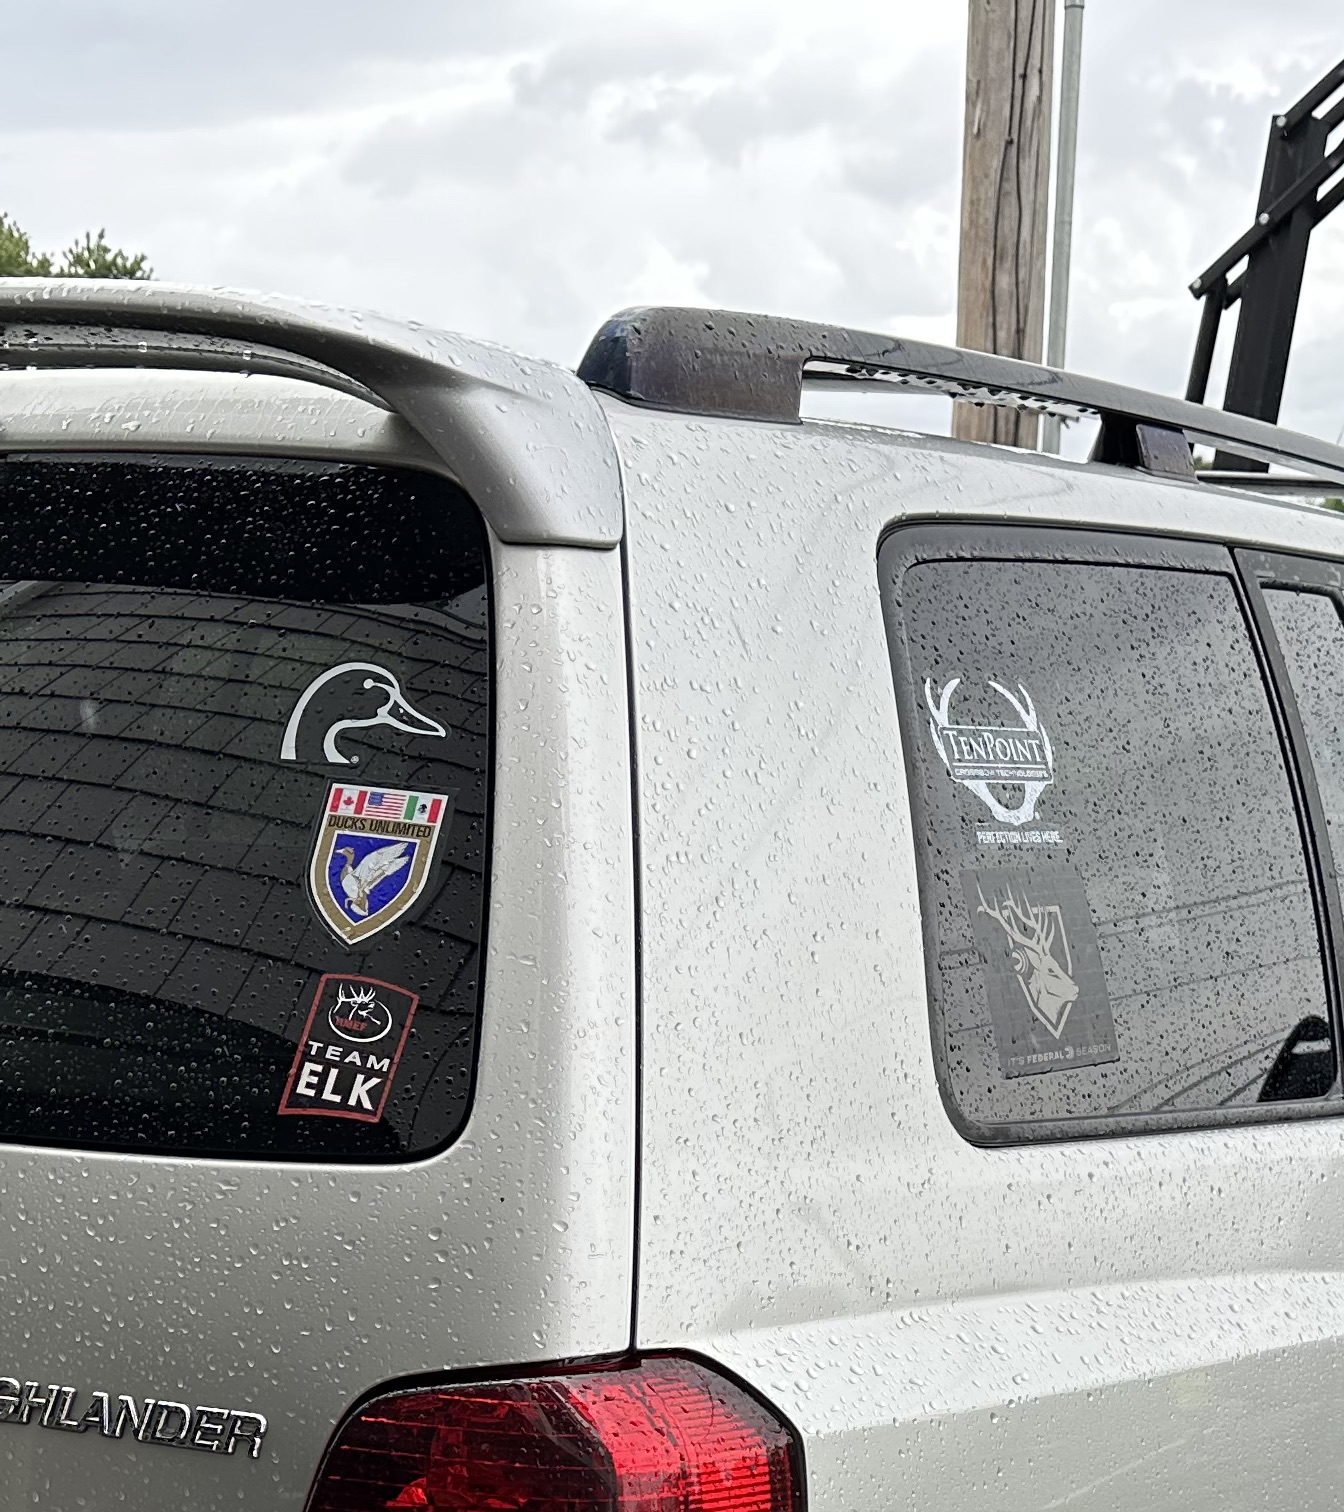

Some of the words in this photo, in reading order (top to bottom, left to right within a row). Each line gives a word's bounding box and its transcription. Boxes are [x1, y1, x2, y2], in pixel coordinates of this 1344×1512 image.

[328, 814, 367, 831] DUCKS
[369, 819, 432, 838] UNLIMITED
[308, 1040, 391, 1072] TEAM
[1026, 1050, 1065, 1065] FEDERAL
[1076, 1043, 1112, 1057] SEASON
[296, 1061, 383, 1111] ELK
